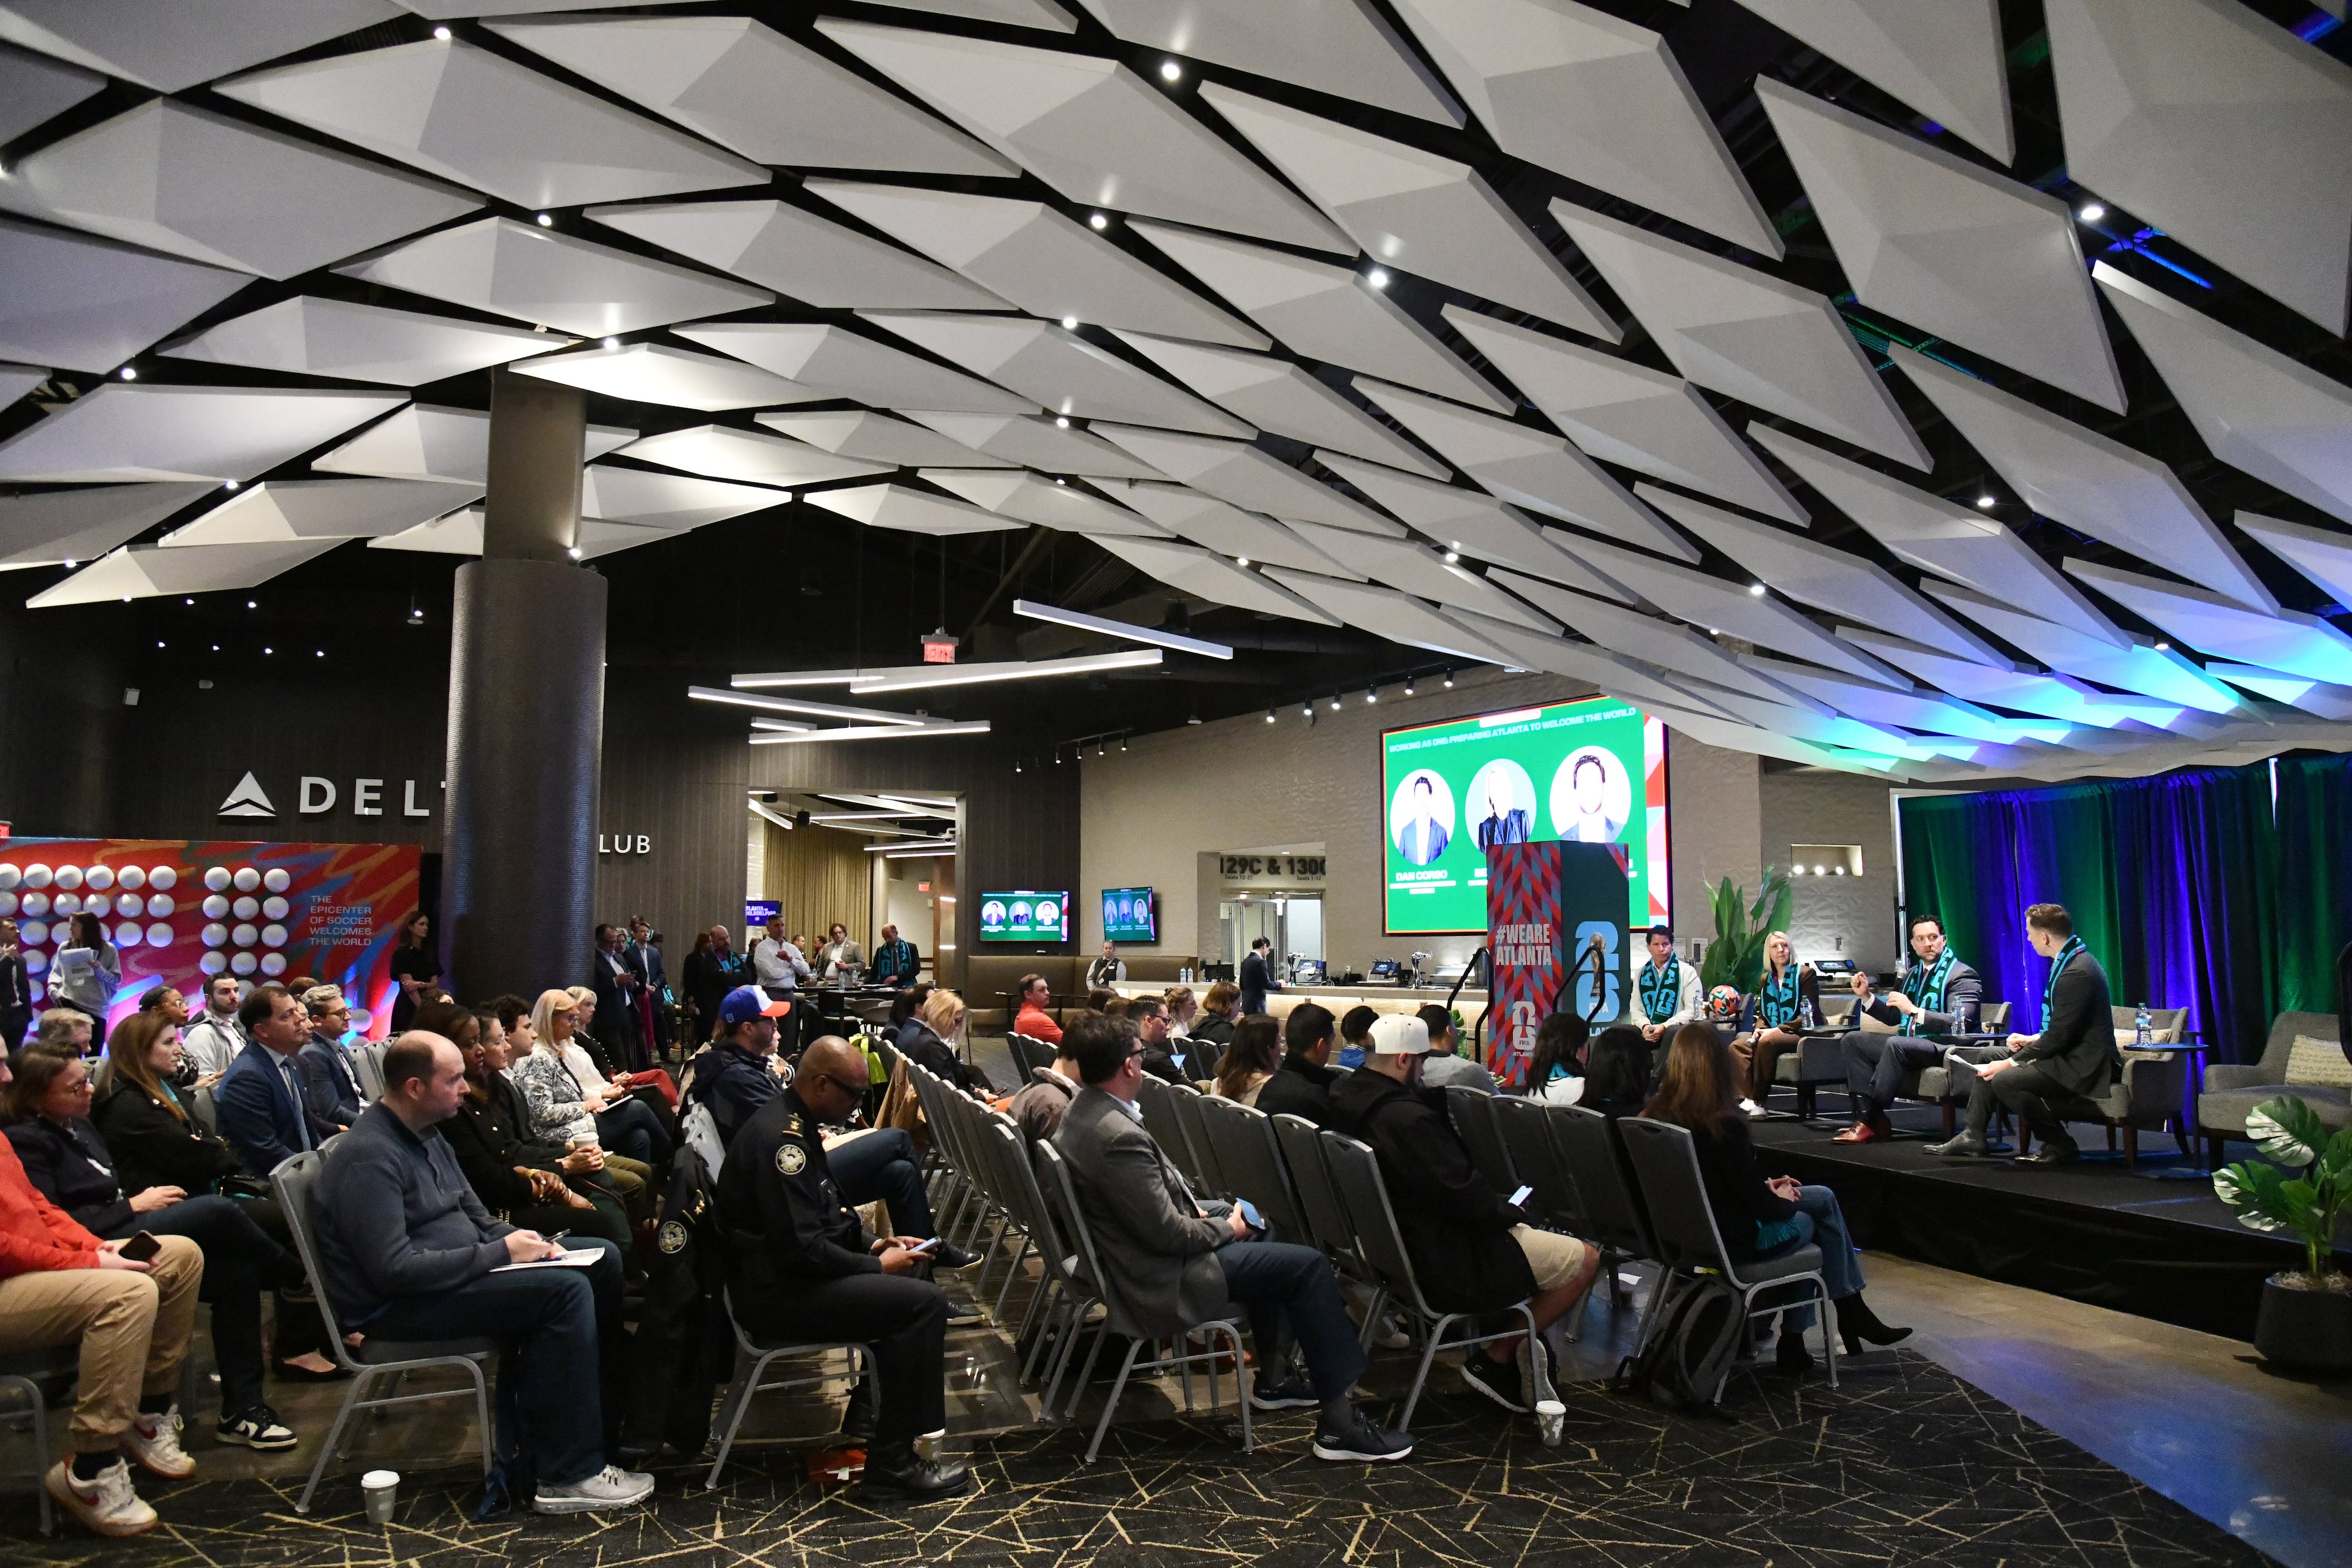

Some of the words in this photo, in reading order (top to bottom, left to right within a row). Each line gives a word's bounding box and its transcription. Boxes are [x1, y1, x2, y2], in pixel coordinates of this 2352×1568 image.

[1389, 740, 1421, 753] WORKING
[1421, 739, 1432, 748] AS
[1449, 730, 1491, 744] PREPARING
[1492, 724, 1529, 737] ATLANTA
[1529, 722, 1542, 731] TO
[1542, 715, 1585, 729] WELCOME
[1585, 712, 1603, 723] THE
[1603, 707, 1637, 720] WORLD
[300, 776, 447, 816] DEL
[599, 834, 650, 854] LUB
[1267, 858, 1281, 875] &
[1396, 872, 1415, 881] DAN
[1415, 870, 1447, 880] CORSO
[310, 906, 372, 914] EPICENTER
[327, 916, 372, 925] SOCCER
[1496, 924, 1550, 944] #WEARE
[1496, 946, 1552, 966] ATLANTA
